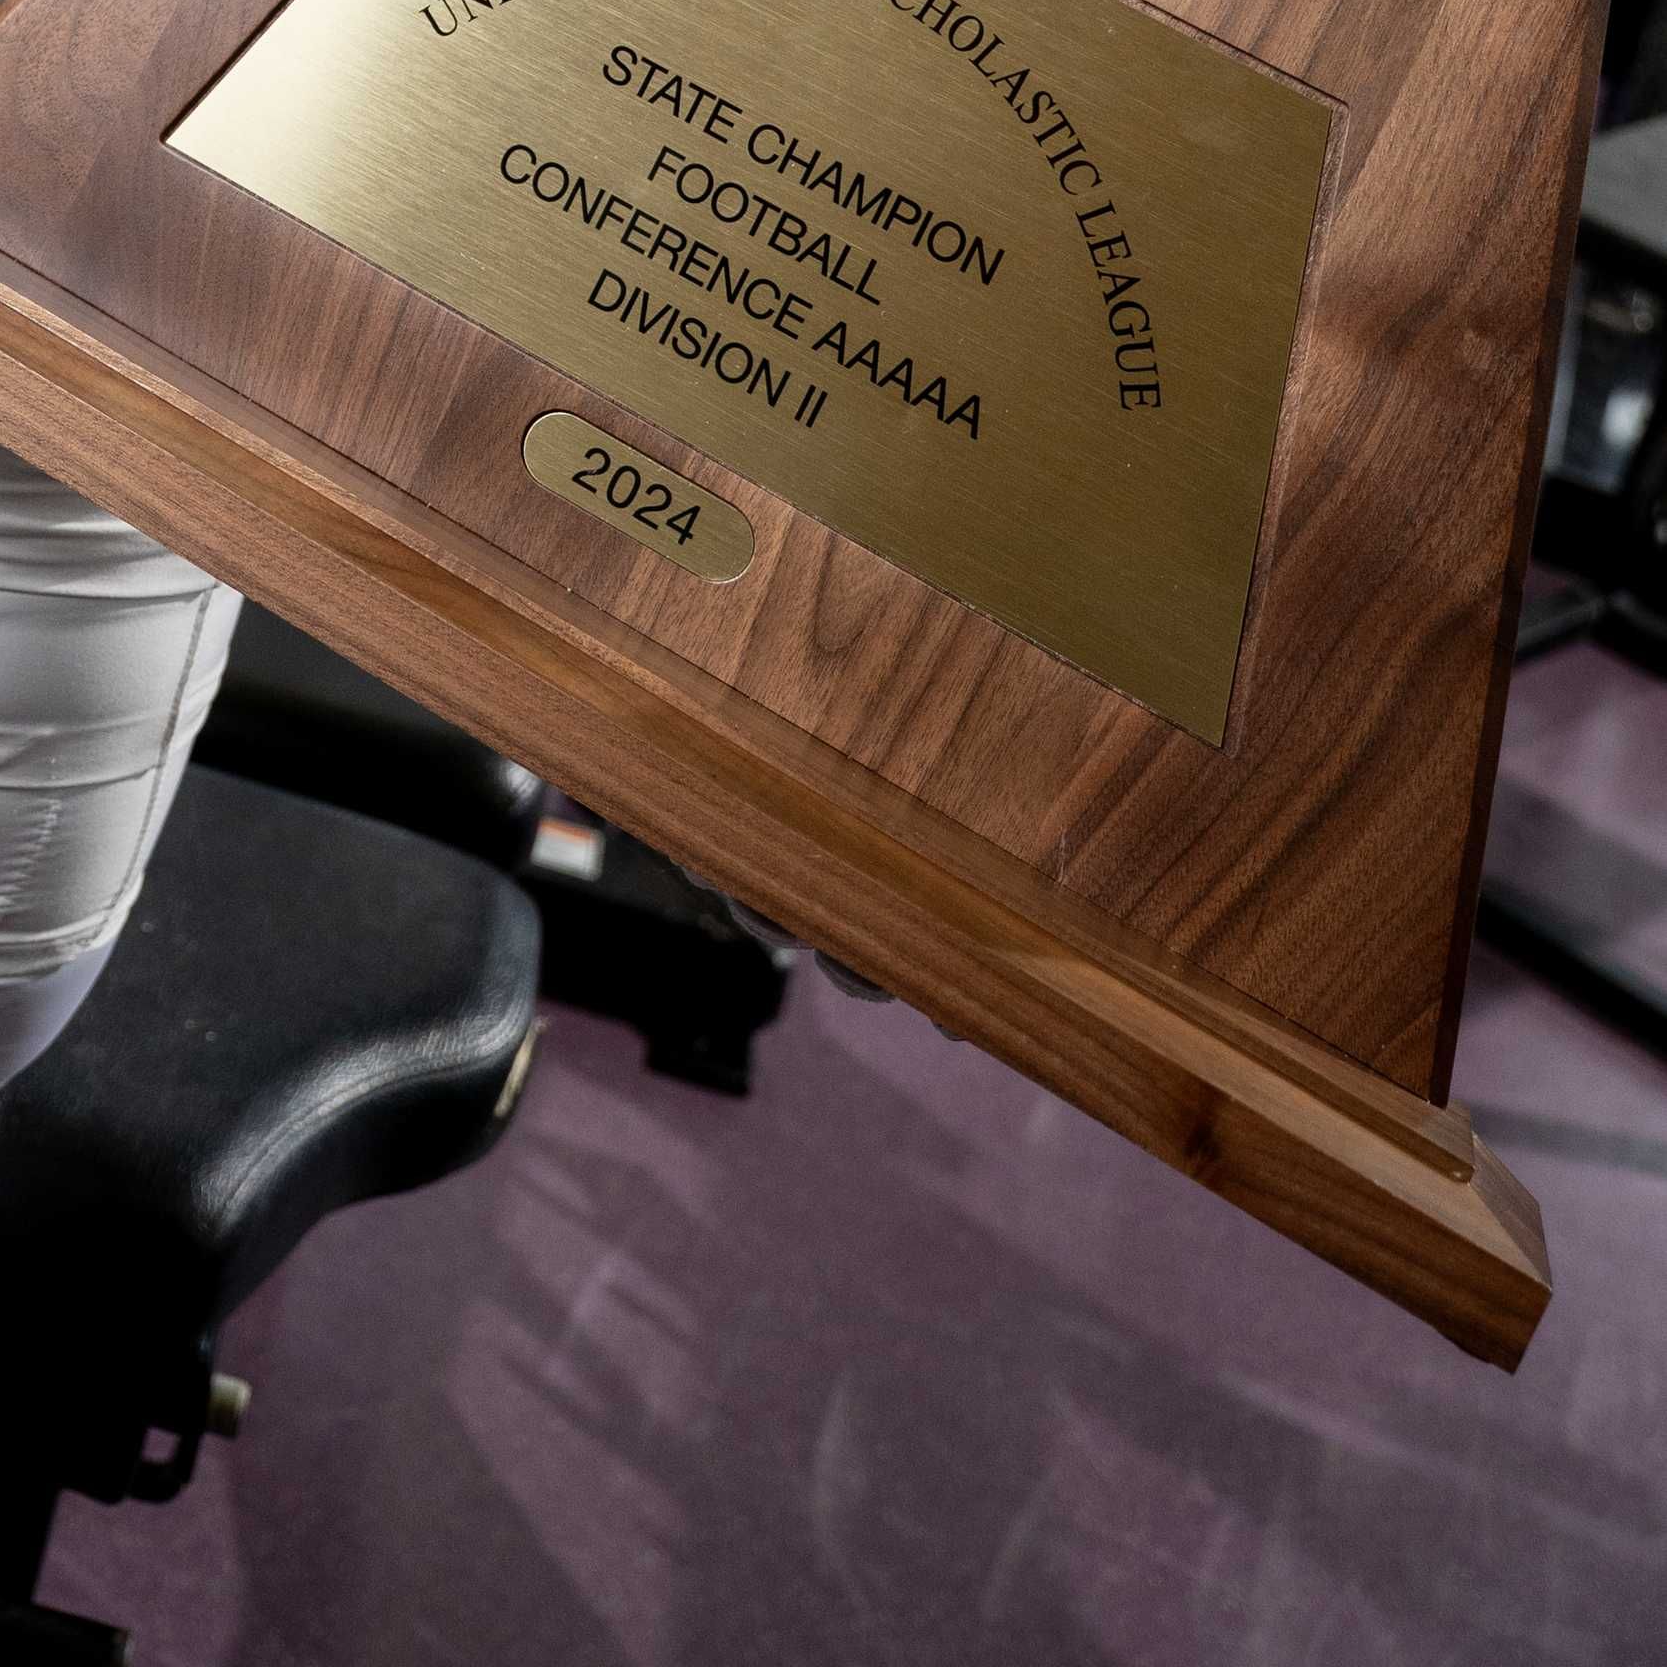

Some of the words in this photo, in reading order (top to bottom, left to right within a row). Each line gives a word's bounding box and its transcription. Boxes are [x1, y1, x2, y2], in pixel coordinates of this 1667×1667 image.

[603, 46, 742, 145] STATE
[746, 123, 1005, 286] CHAMPION
[647, 146, 883, 305] FOOTBALL
[499, 144, 813, 340] CONFERENCE
[812, 322, 982, 440] AAAAA
[588, 269, 792, 411] DIVISION
[795, 385, 829, 428] II
[1076, 201, 1162, 412] LEAGUE
[571, 446, 701, 547] 2024
